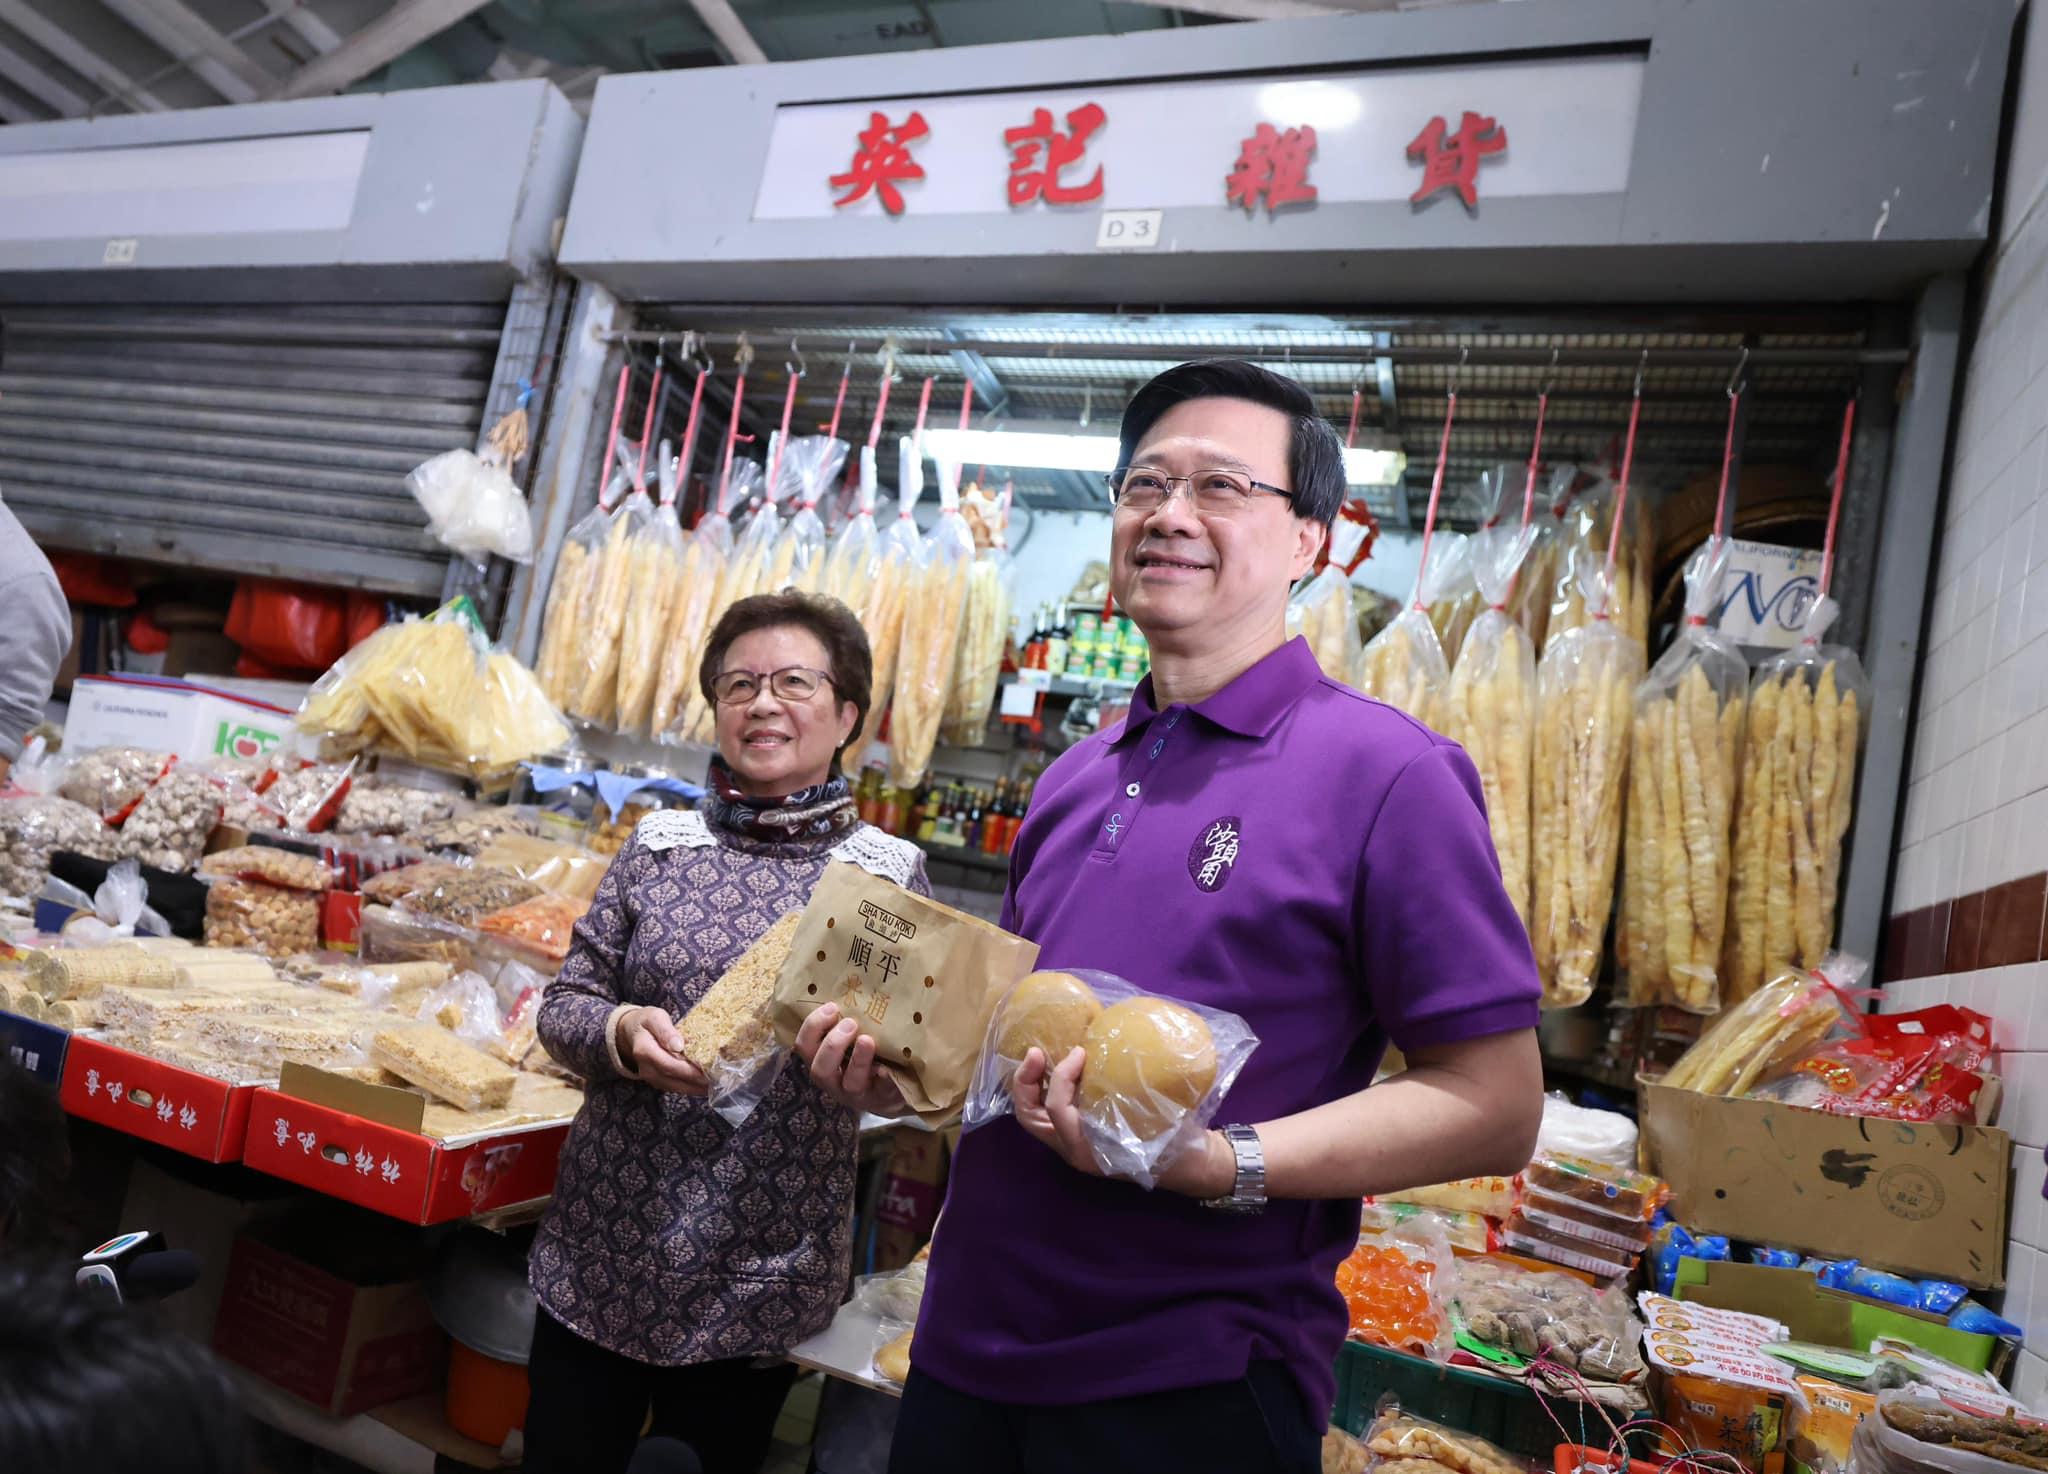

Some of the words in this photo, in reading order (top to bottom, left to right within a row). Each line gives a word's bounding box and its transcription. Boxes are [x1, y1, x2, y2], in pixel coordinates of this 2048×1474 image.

[829, 100, 1509, 216] 英記雜貨
[862, 903, 878, 920] SHA
[879, 910, 895, 928] TAU
[895, 918, 912, 936] KOK
[847, 935, 902, 983] 順平
[841, 974, 892, 1025] 米通
